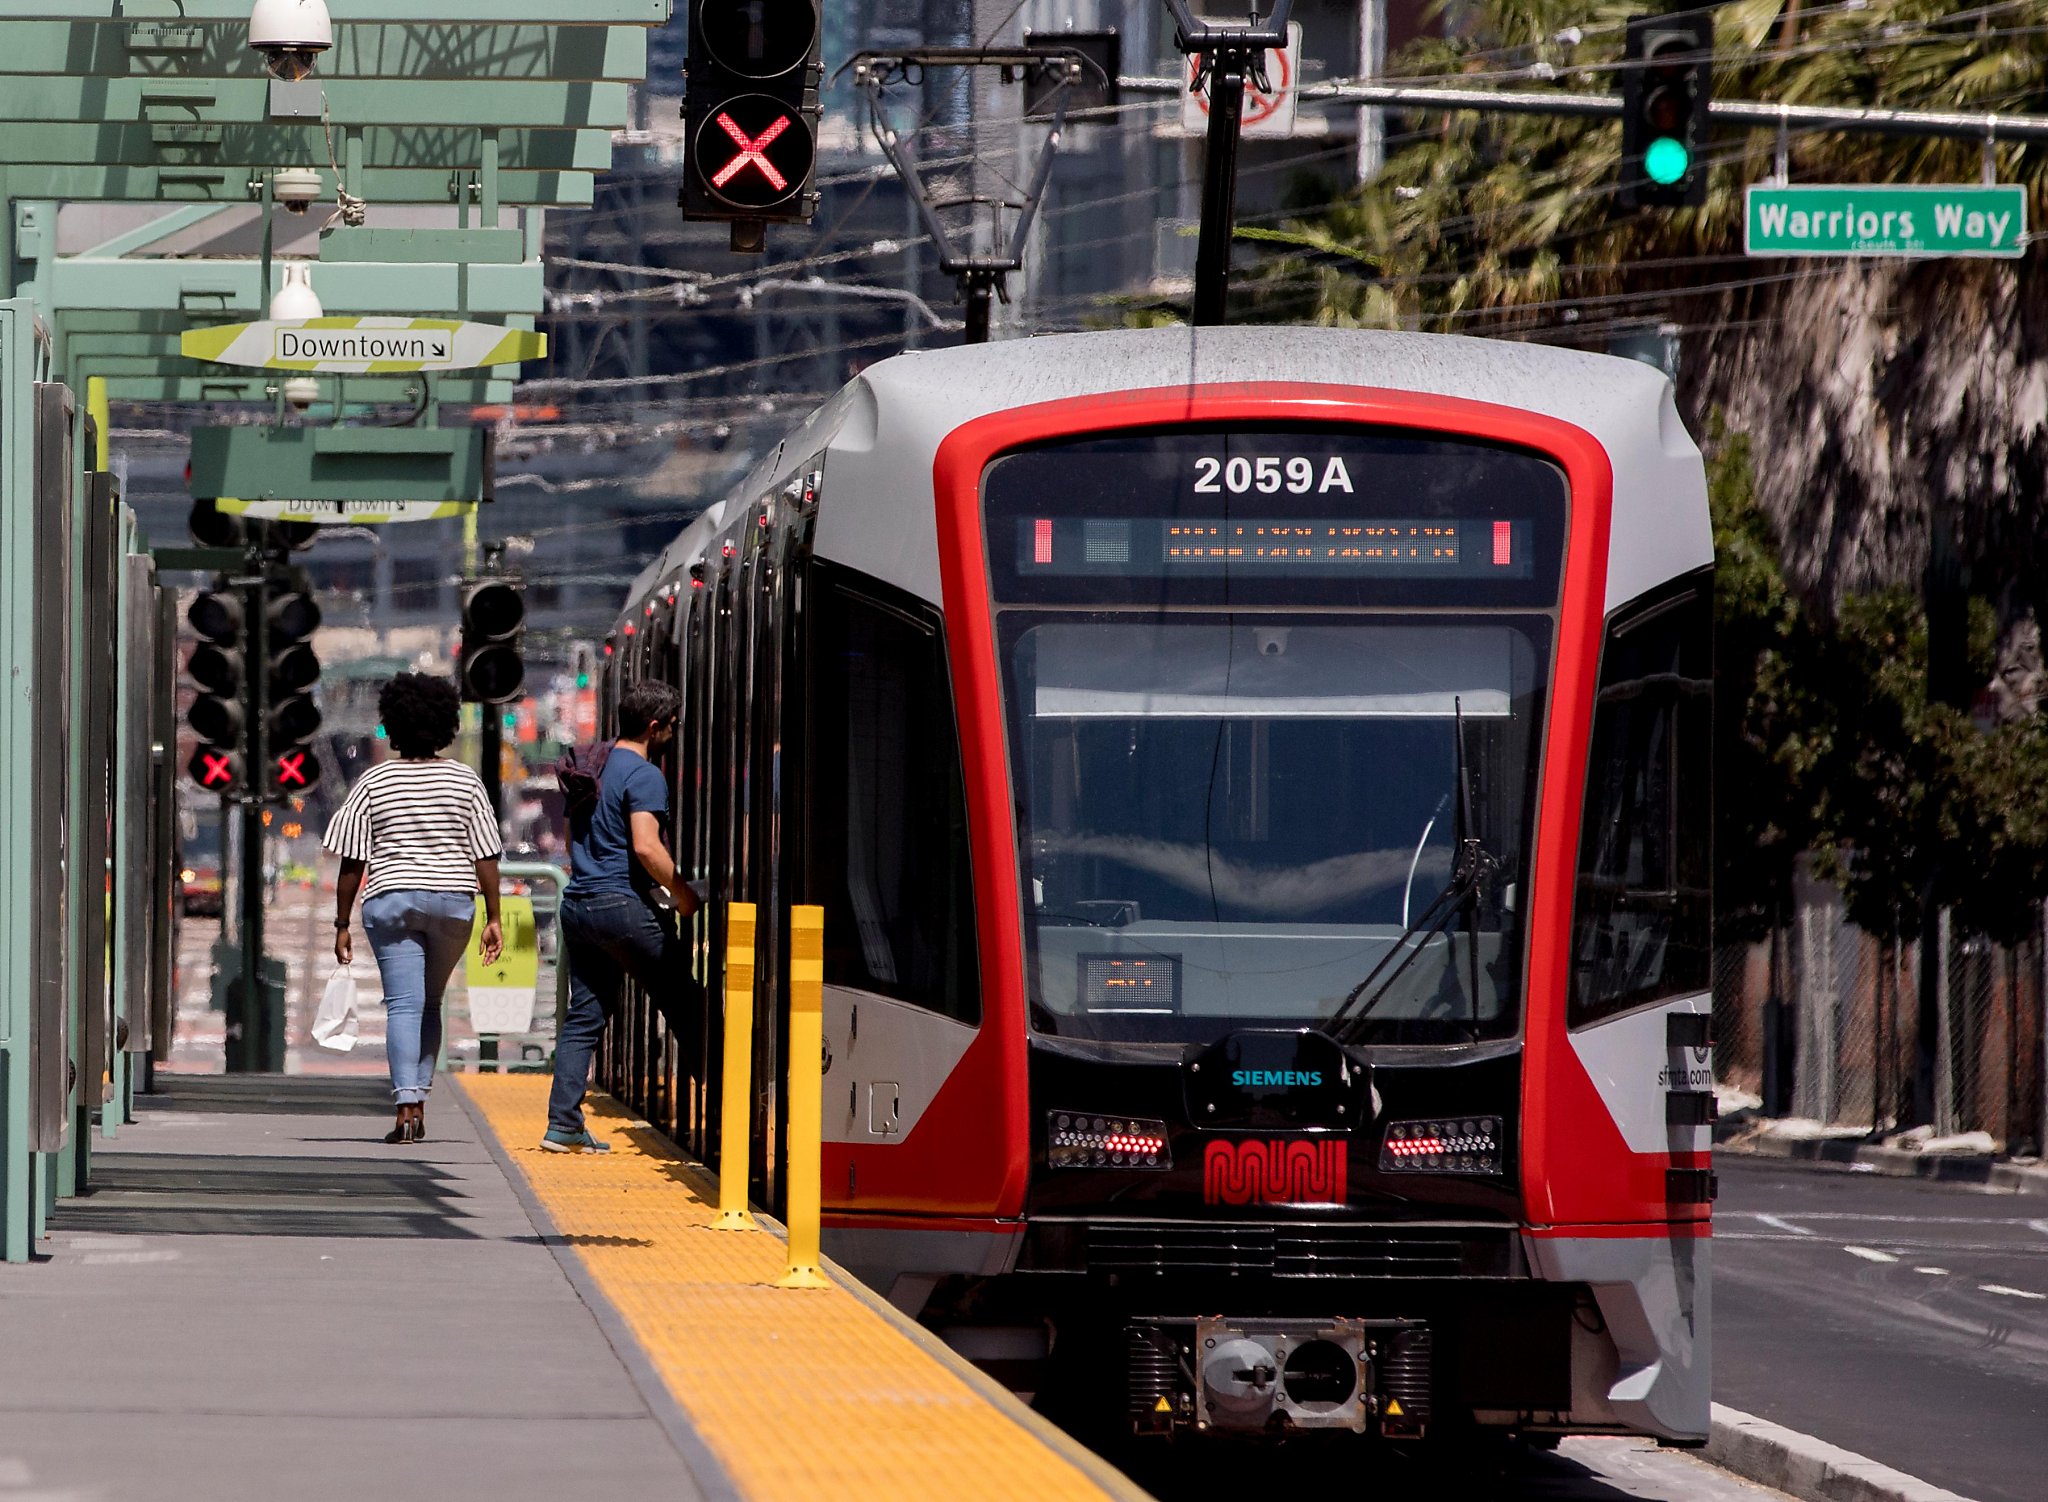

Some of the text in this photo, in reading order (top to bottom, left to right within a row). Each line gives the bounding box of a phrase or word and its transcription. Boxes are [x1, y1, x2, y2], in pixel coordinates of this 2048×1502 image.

[1758, 203, 2012, 249] Warriors Way
[282, 333, 425, 358] Downtown
[1194, 456, 1354, 494] 2059A
[1232, 1070, 1323, 1086] SIEMENS
[1658, 1065, 1711, 1087] sfmta.com
[1204, 1140, 1348, 1206] MUNI
